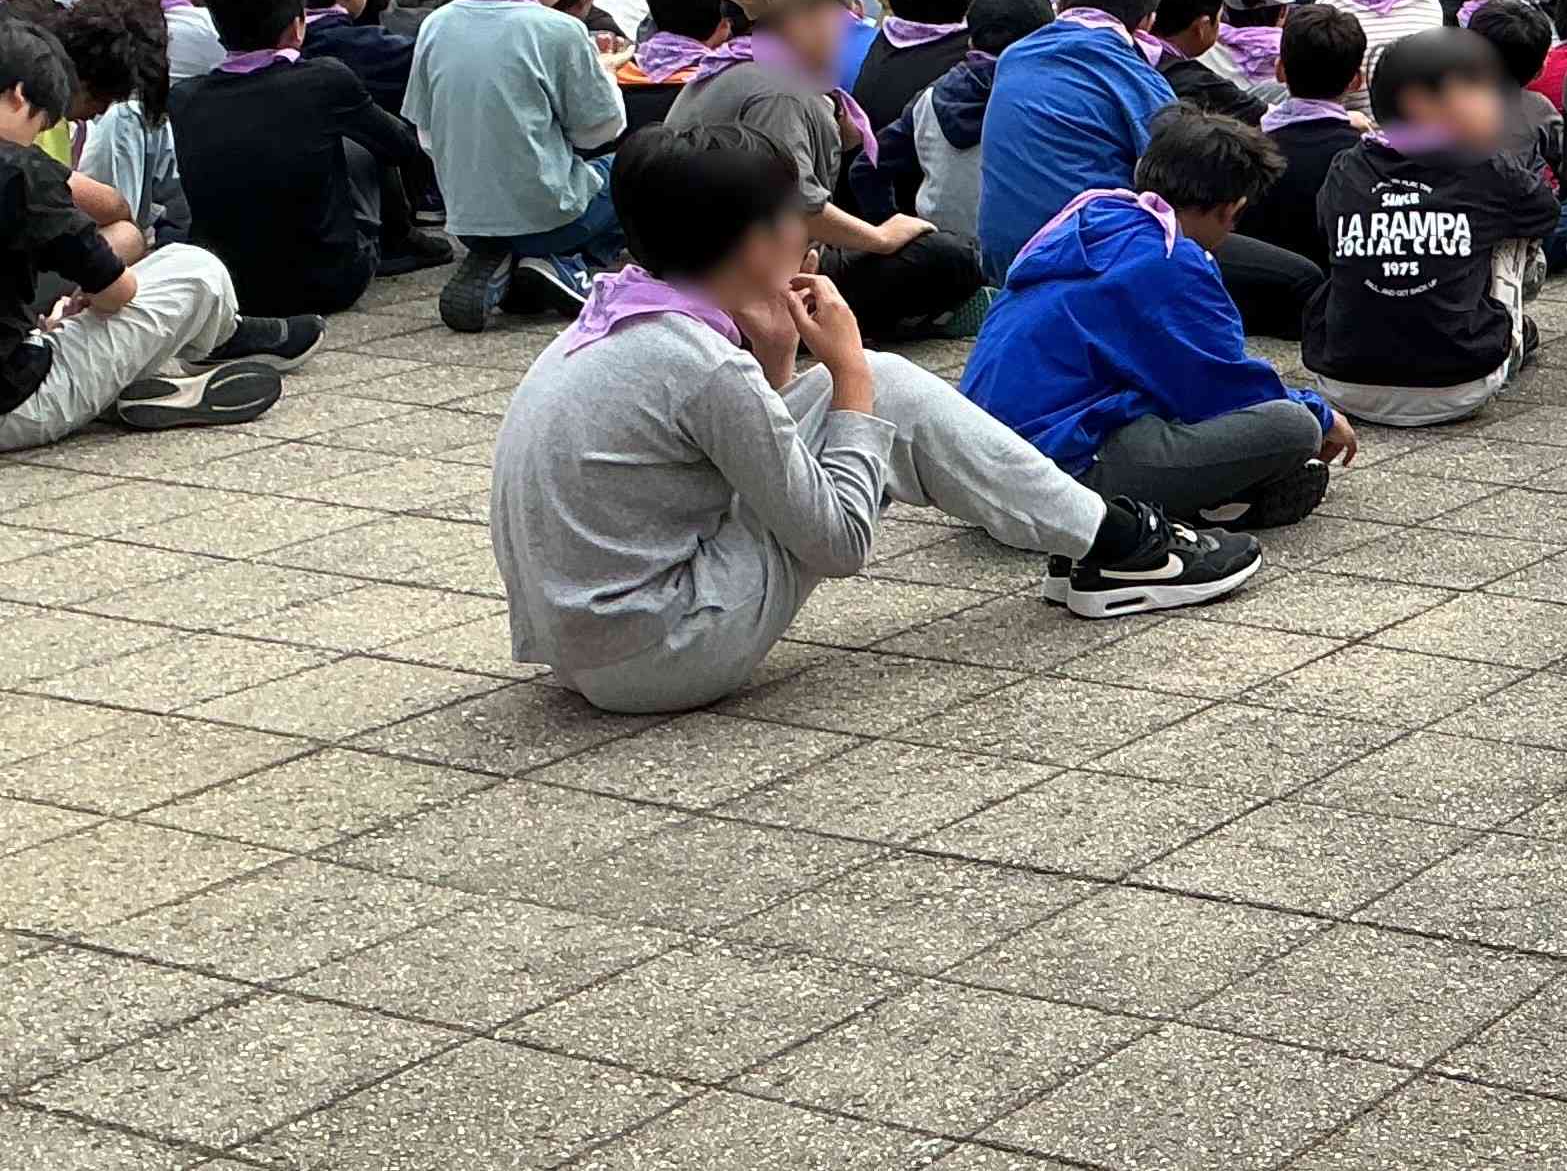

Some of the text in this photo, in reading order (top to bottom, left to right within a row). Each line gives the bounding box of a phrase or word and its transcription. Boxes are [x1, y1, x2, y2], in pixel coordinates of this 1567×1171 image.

[1381, 192, 1420, 208] SINCE
[1336, 210, 1472, 242] LA RAMPA
[1335, 235, 1472, 258] SOCIAL CLUB
[1381, 261, 1420, 277] 1975
